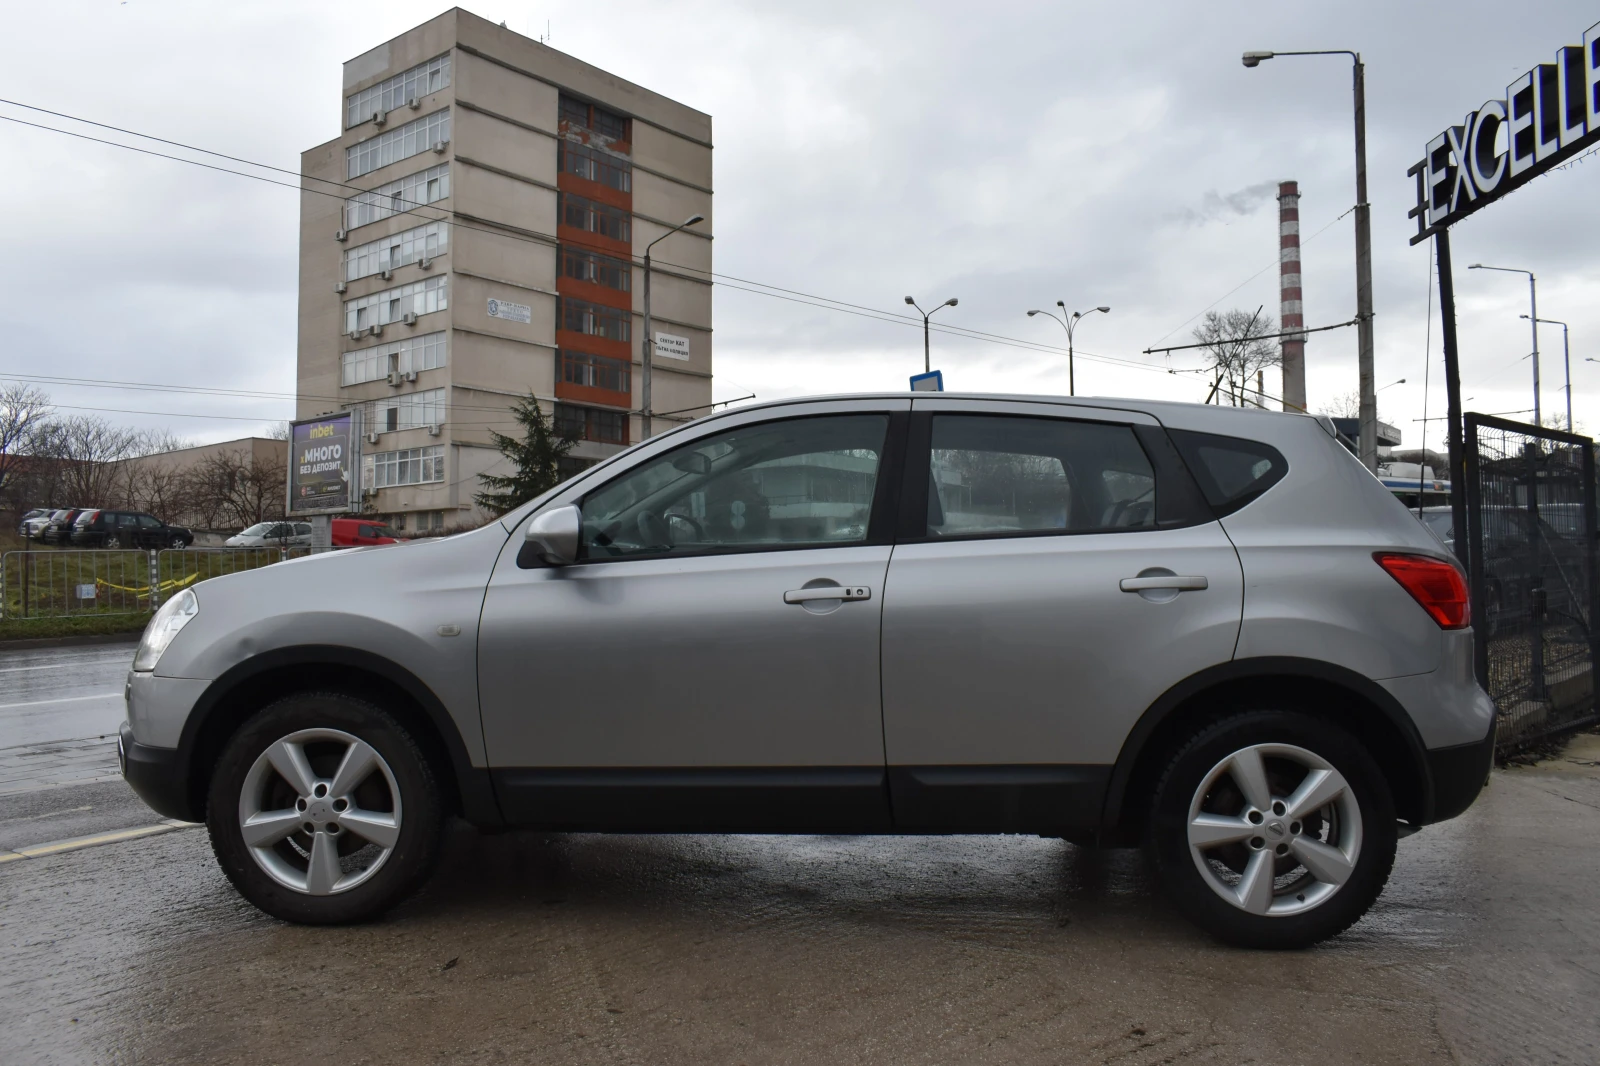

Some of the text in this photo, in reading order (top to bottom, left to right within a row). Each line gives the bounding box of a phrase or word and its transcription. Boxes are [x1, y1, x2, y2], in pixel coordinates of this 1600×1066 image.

[309, 423, 334, 439] inbet
[300, 460, 341, 475] БЕЗ ДЕПОЗИТ
